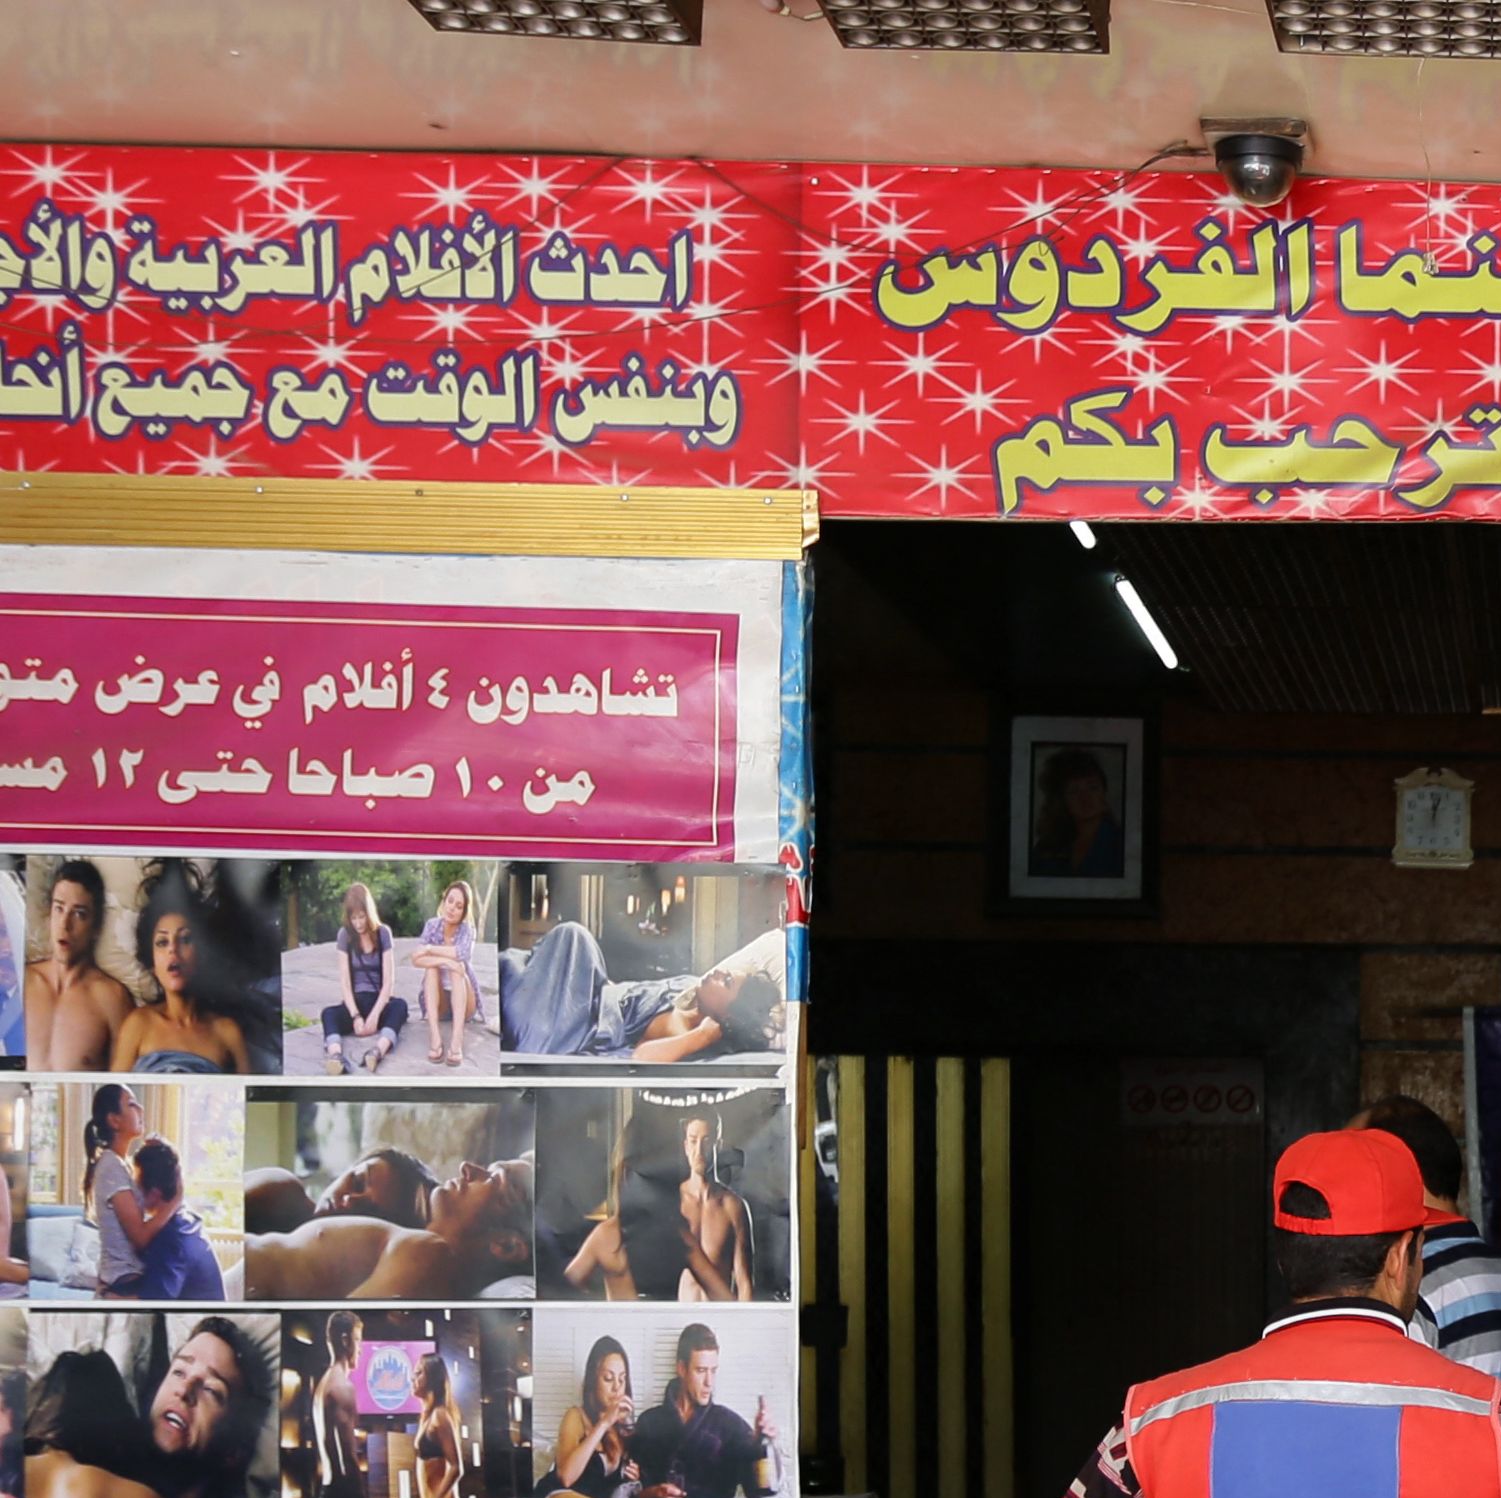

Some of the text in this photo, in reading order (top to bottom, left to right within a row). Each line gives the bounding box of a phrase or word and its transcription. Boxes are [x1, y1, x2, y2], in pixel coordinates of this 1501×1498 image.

[127, 222, 334, 312] العربية
[346, 211, 517, 323] الأفلام
[876, 218, 1314, 334] الفردوس
[0, 322, 738, 449] وبنفس الوقت مع جميع أنحا
[994, 388, 1180, 518] بكم
[94, 656, 219, 717] عرض
[234, 655, 281, 729] في
[303, 649, 413, 725] أفلام
[428, 672, 449, 709] ٤
[466, 670, 678, 726] تشاهدون
[158, 751, 273, 804] حتى
[287, 748, 435, 810] صباحا
[522, 767, 596, 814] من
